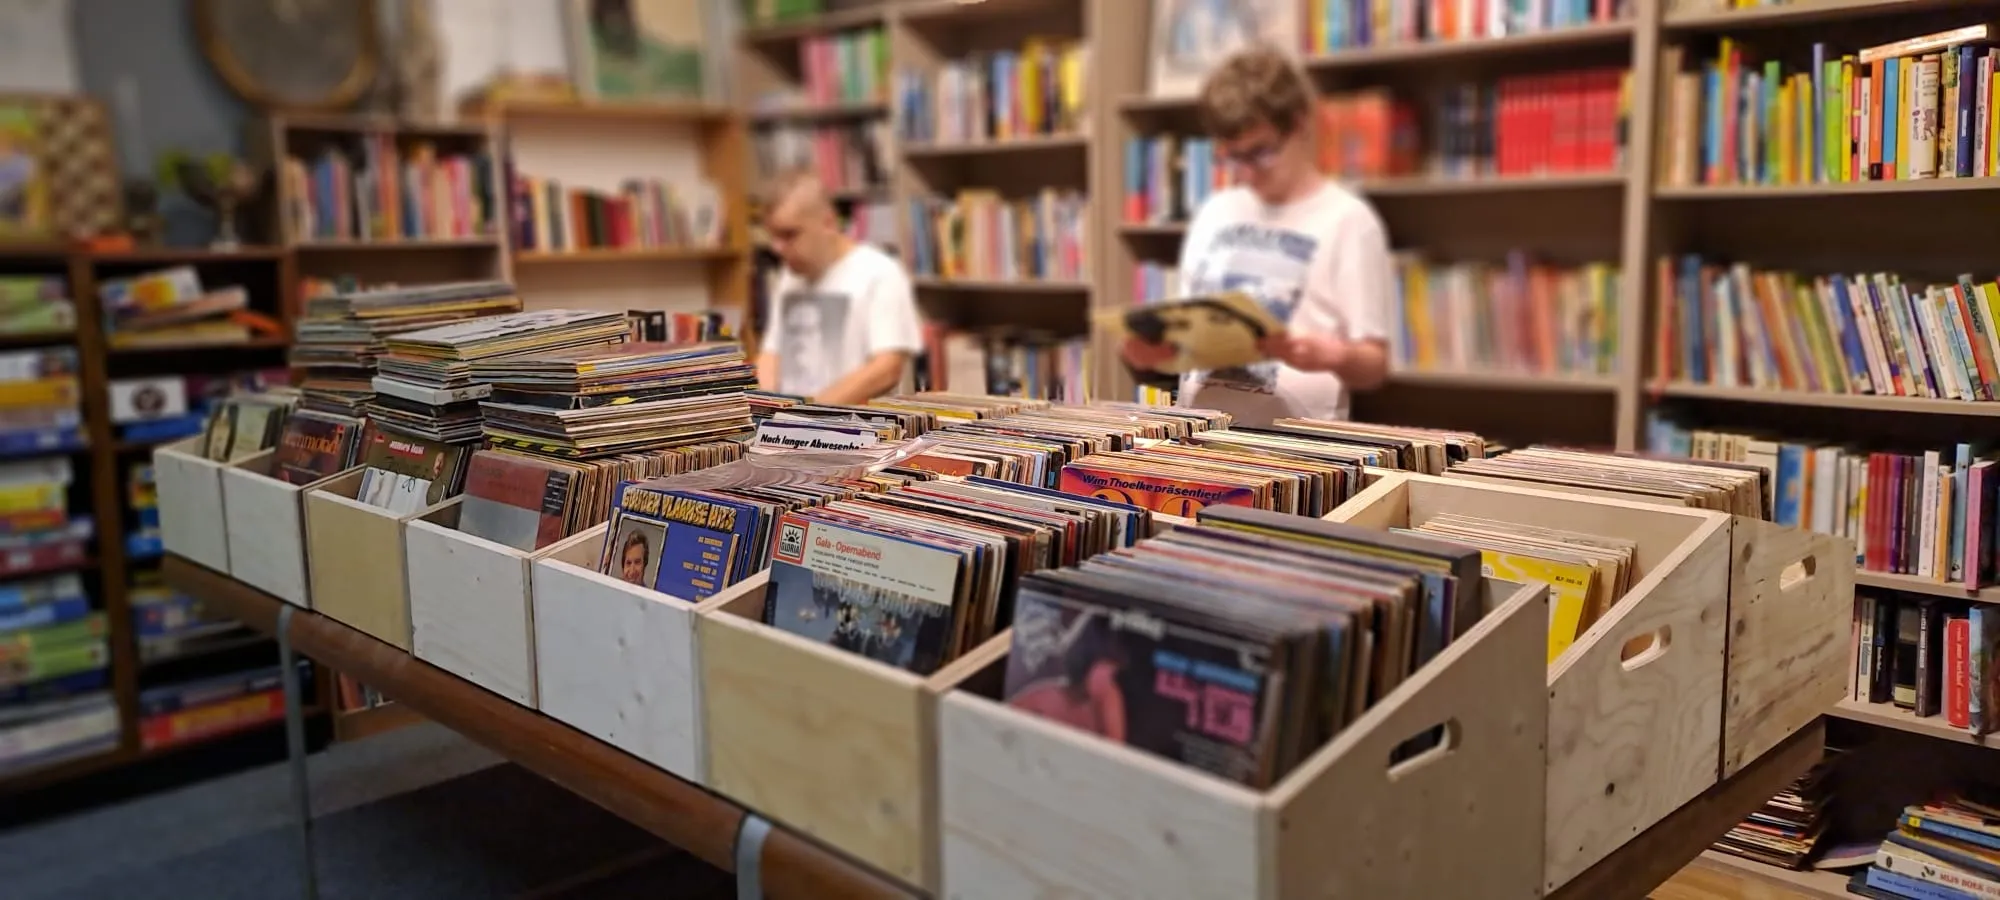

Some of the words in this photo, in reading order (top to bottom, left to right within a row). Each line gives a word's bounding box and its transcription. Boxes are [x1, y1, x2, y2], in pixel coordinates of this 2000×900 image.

[760, 433, 780, 445] Nach
[781, 435, 810, 449] langer
[1083, 474, 1107, 486] Wim
[1109, 477, 1153, 492] Thoelke
[661, 494, 710, 527] VLAAMSE
[707, 503, 737, 533] HITS
[780, 541, 800, 553] GLORIA
[815, 536, 831, 549] Gala
[836, 541, 882, 560] Opernabend
